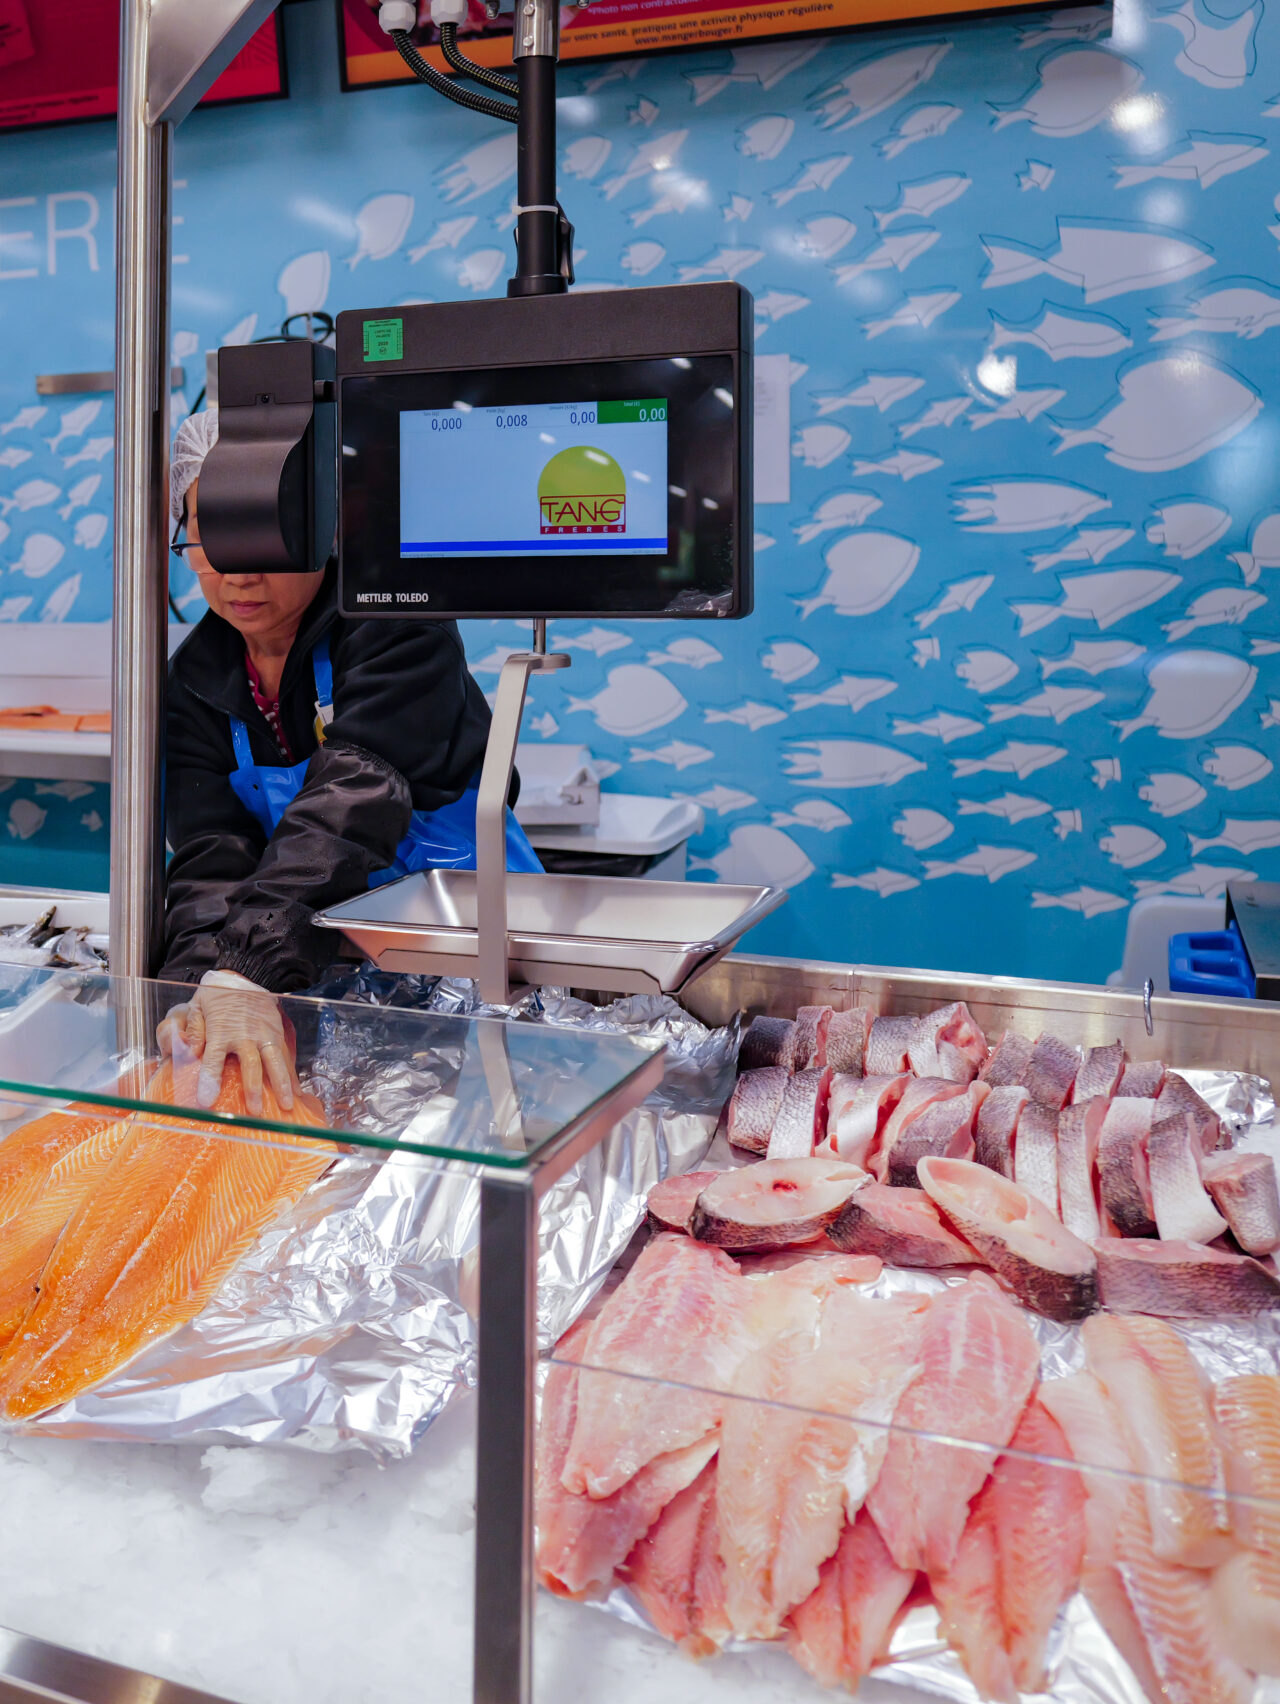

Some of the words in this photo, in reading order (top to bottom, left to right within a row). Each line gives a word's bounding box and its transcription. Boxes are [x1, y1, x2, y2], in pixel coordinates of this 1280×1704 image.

[574, 33, 599, 41] votre
[632, 23, 677, 35] pratiquez
[680, 20, 698, 28] une
[701, 14, 737, 26] activité
[740, 9, 785, 23] physique
[788, 3, 834, 16] régulière
[634, 24, 743, 45] www.mangerbouger.fr
[496, 414, 528, 429] 0,008
[570, 411, 595, 426] 0,00
[639, 407, 666, 423] 0,00
[431, 417, 462, 431] 0,000
[540, 498, 625, 523] TANG
[544, 525, 623, 534] FRERES
[356, 593, 392, 603] METTLER
[395, 593, 429, 603] TOLEDO
